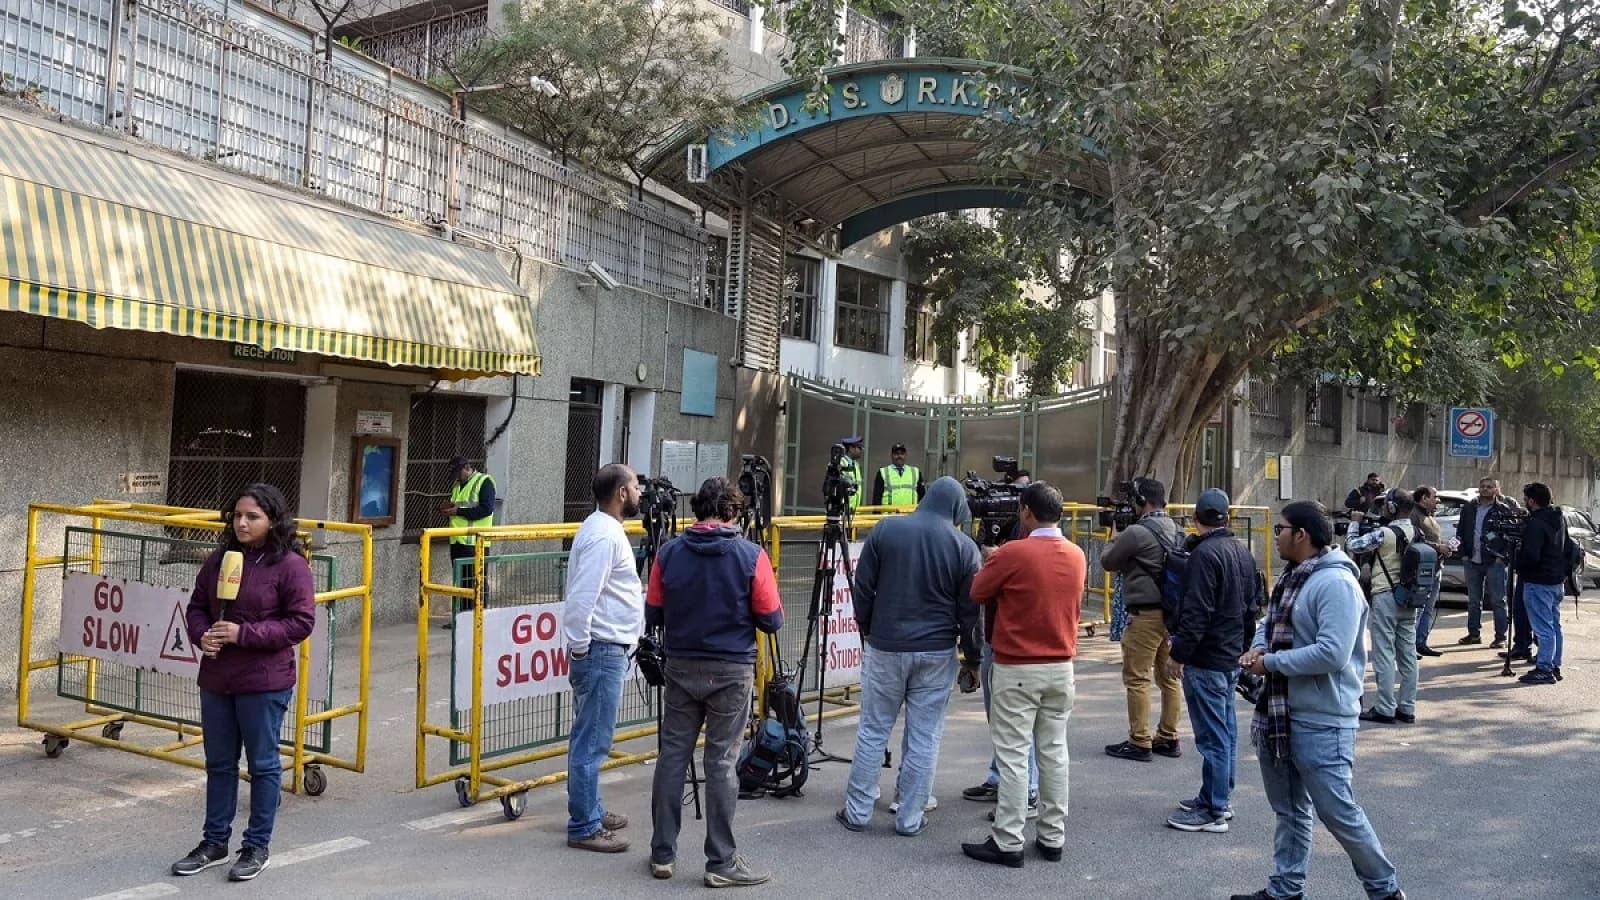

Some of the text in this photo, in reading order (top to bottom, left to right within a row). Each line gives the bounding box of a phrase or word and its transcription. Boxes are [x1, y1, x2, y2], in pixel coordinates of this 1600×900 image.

[234, 345, 294, 361] RECEPTION
[94, 581, 123, 613] GO
[82, 615, 140, 654] SLOW
[511, 612, 557, 645] GO
[496, 647, 569, 688] SLOW
